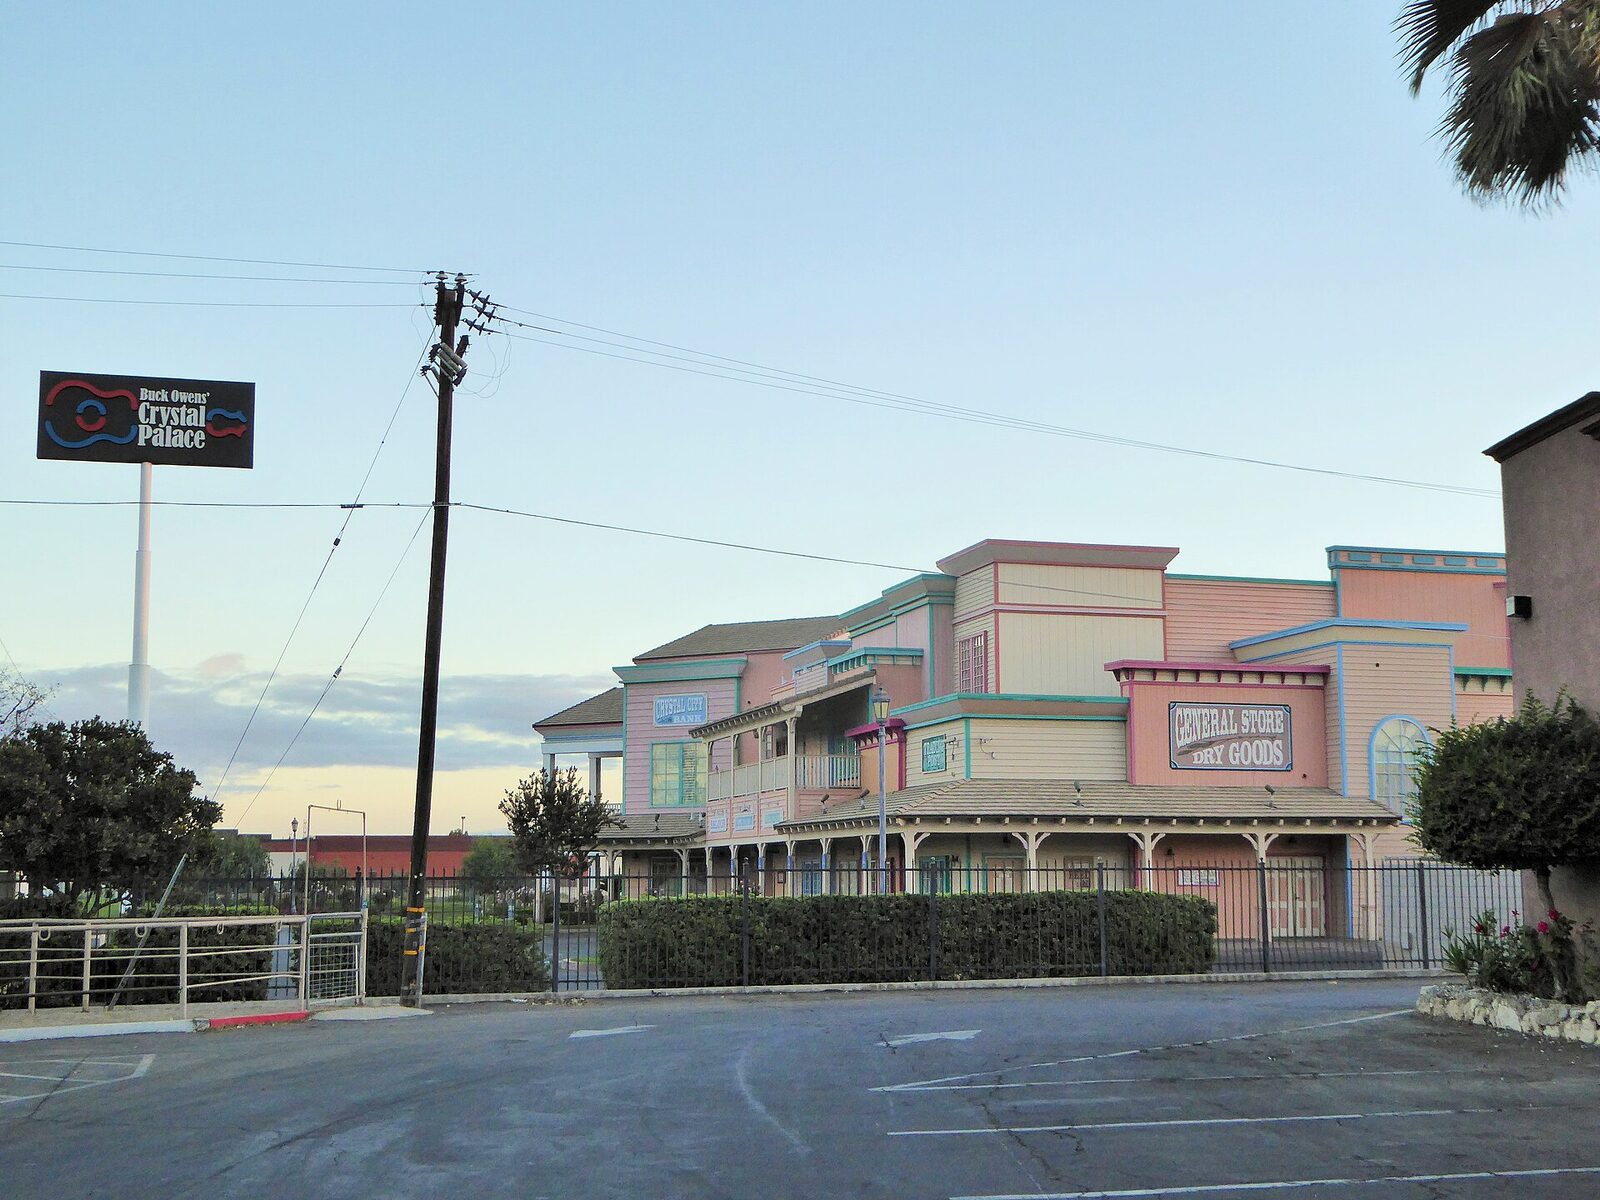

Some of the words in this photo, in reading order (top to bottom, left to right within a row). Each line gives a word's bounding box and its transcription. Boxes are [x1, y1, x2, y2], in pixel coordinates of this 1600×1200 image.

[140, 388, 169, 402] Buck
[138, 402, 206, 427] Crystal
[137, 424, 206, 449] Palace
[656, 698, 686, 720] CRYSTAL
[687, 696, 704, 712] CITY
[673, 714, 703, 723] BANK
[1175, 707, 1238, 749] GENERAL
[1241, 709, 1284, 734] STORE
[1192, 744, 1225, 765] DRY
[1229, 739, 1284, 766] GOODS
